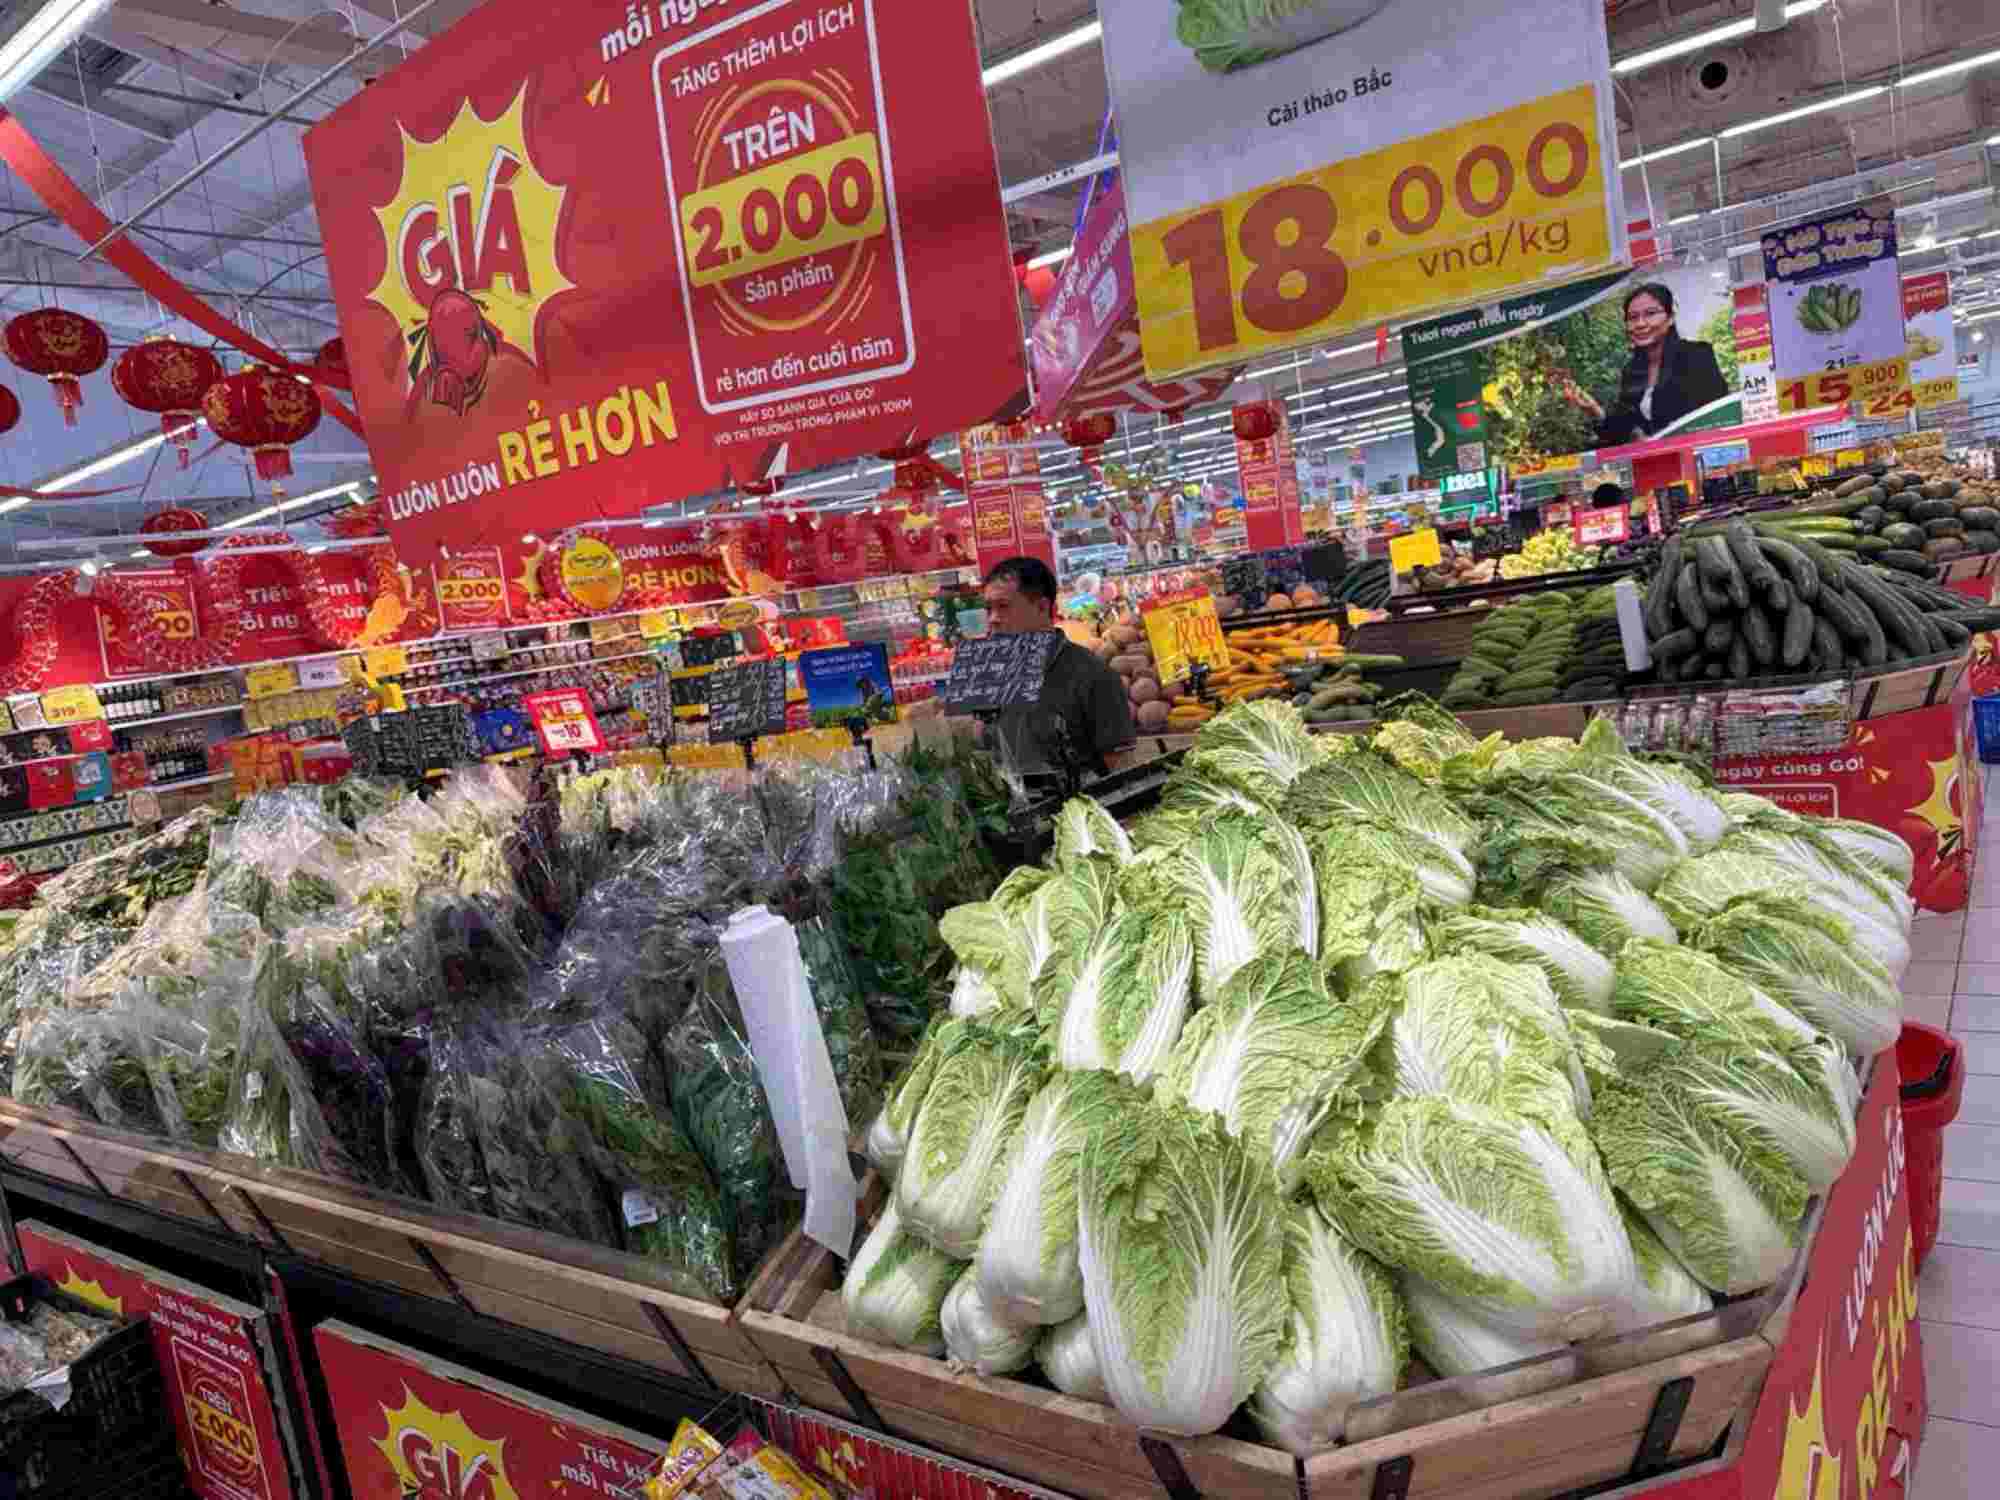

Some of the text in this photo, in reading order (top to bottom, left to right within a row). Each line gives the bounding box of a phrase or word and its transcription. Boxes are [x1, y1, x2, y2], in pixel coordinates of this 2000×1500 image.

[600, 0, 729, 61] mỗi ng
[671, 4, 856, 98] TĂNG THÊM LỢI ÍCH
[1267, 64, 1393, 127] Cải thảo Bắc
[722, 104, 817, 170] TRÊN
[398, 145, 532, 308] GIÁ
[689, 157, 875, 272] 2.000
[1161, 121, 1590, 353] 18.000
[1417, 215, 1571, 280] vnd/kg
[744, 256, 833, 303] Sản phẩm
[716, 336, 893, 393] rẻ hơn đến cuối năm
[1781, 372, 1852, 410] 15
[1863, 365, 1899, 384] 900
[761, 406, 776, 420] SO
[796, 411, 834, 431] TRONG
[1868, 390, 1917, 415] 24
[388, 381, 679, 521] LUÔN LUÔN RẺ HƠN
[440, 582, 501, 600] 2.000
[240, 609, 264, 631] ỗi
[1771, 760, 1823, 777] cùng
[1829, 756, 1864, 773] GO!
[1846, 1210, 1885, 1353] LUÔN
[561, 1463, 597, 1490] mỗi
[578, 1440, 618, 1472] Tiết
